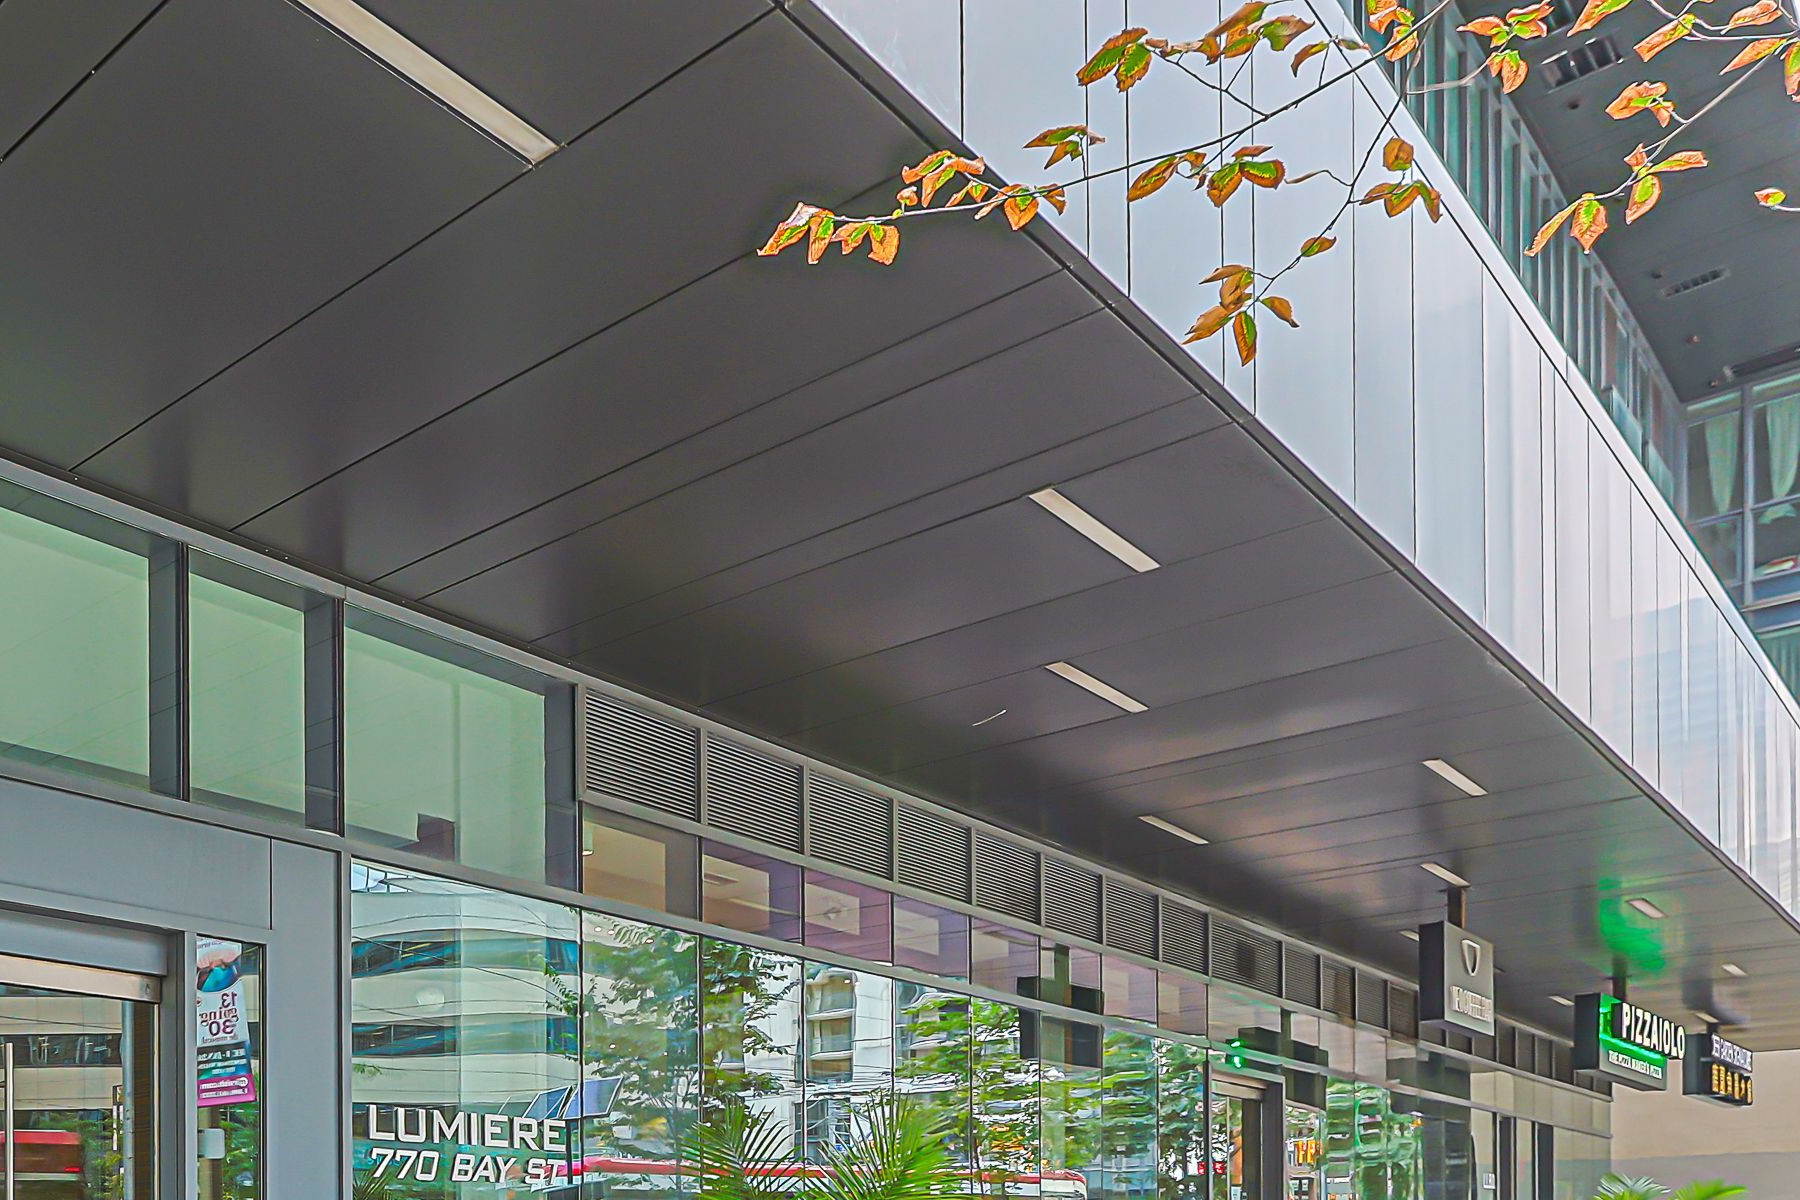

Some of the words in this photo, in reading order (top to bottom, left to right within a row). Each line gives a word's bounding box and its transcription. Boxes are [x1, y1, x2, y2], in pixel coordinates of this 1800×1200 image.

[1622, 1002, 1686, 1059] PIZZAIOLO
[368, 1103, 568, 1152] LUMIERE
[371, 1148, 440, 1181] 770
[451, 1153, 518, 1183] BAY
[523, 1158, 568, 1185] ST
